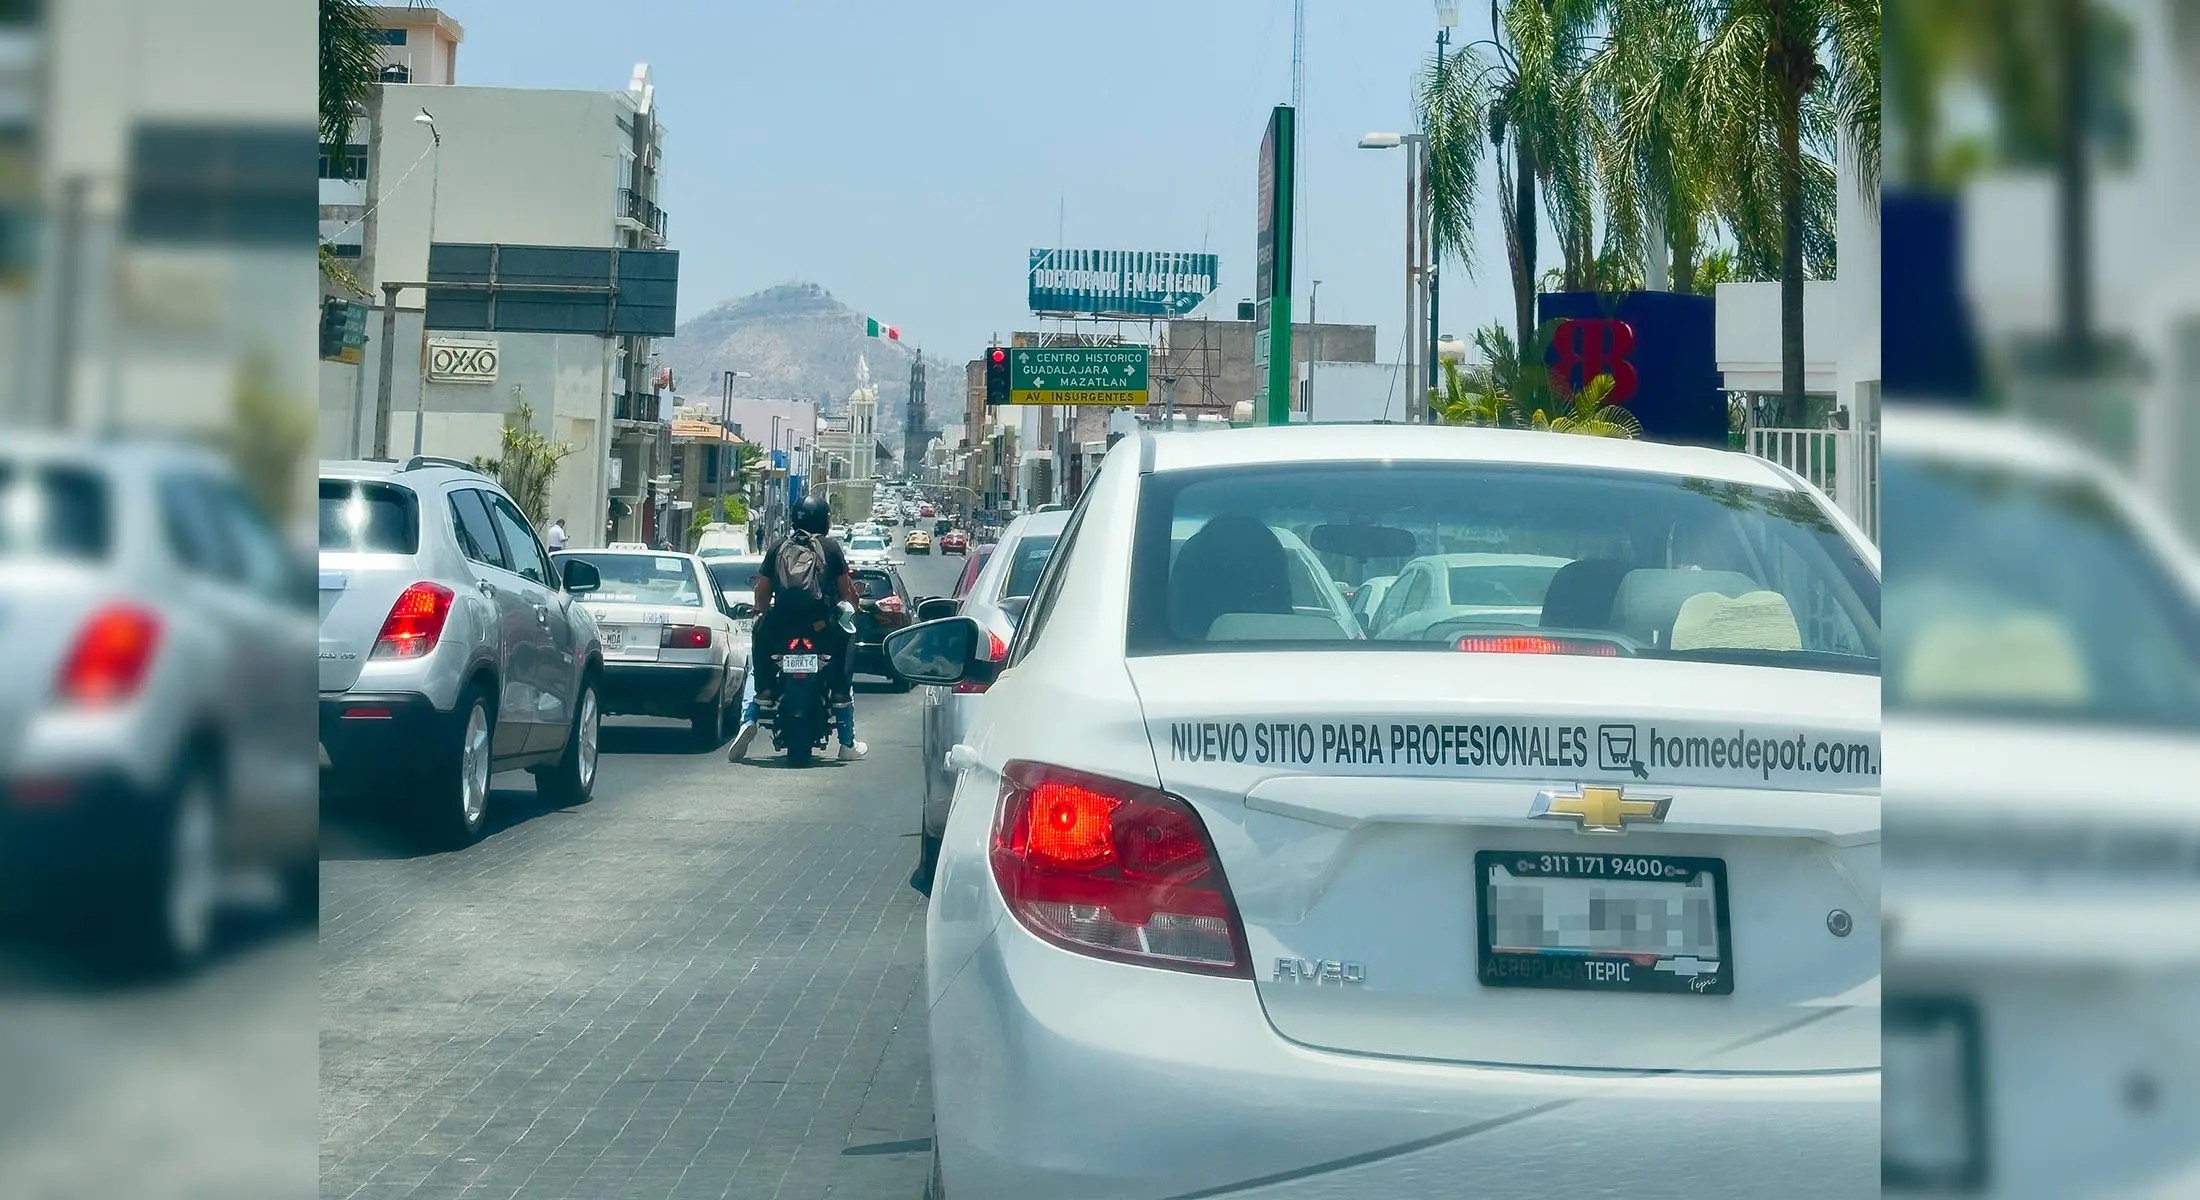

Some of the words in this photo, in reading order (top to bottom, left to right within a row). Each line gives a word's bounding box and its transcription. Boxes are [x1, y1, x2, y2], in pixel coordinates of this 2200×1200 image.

[1035, 269, 1120, 291] DOCTORADO
[1124, 272, 1144, 293] EN
[1148, 272, 1211, 294] DERECHO
[434, 349, 496, 374] OXXO
[1036, 353, 1080, 363] CENTRO
[1085, 353, 1142, 363] HISTORICO
[1023, 365, 1109, 375] GUADALAJARA
[1060, 377, 1127, 387] MAZATLAN
[1025, 392, 1044, 401] AV.
[1051, 392, 1134, 402] INSURGENTES
[1171, 722, 1248, 764] NUEVO
[1255, 722, 1315, 765] SITIO
[1322, 724, 1384, 764] PARA
[1390, 724, 1587, 768] PROFESIONALES
[1650, 727, 1881, 781] homedepot.com.
[1540, 855, 1570, 873] 311
[1576, 856, 1604, 874] 171
[1611, 857, 1663, 877] 9400
[1274, 957, 1367, 982] AVEO
[1584, 961, 1631, 982] TEPIC
[1687, 975, 1718, 993] Tepic
